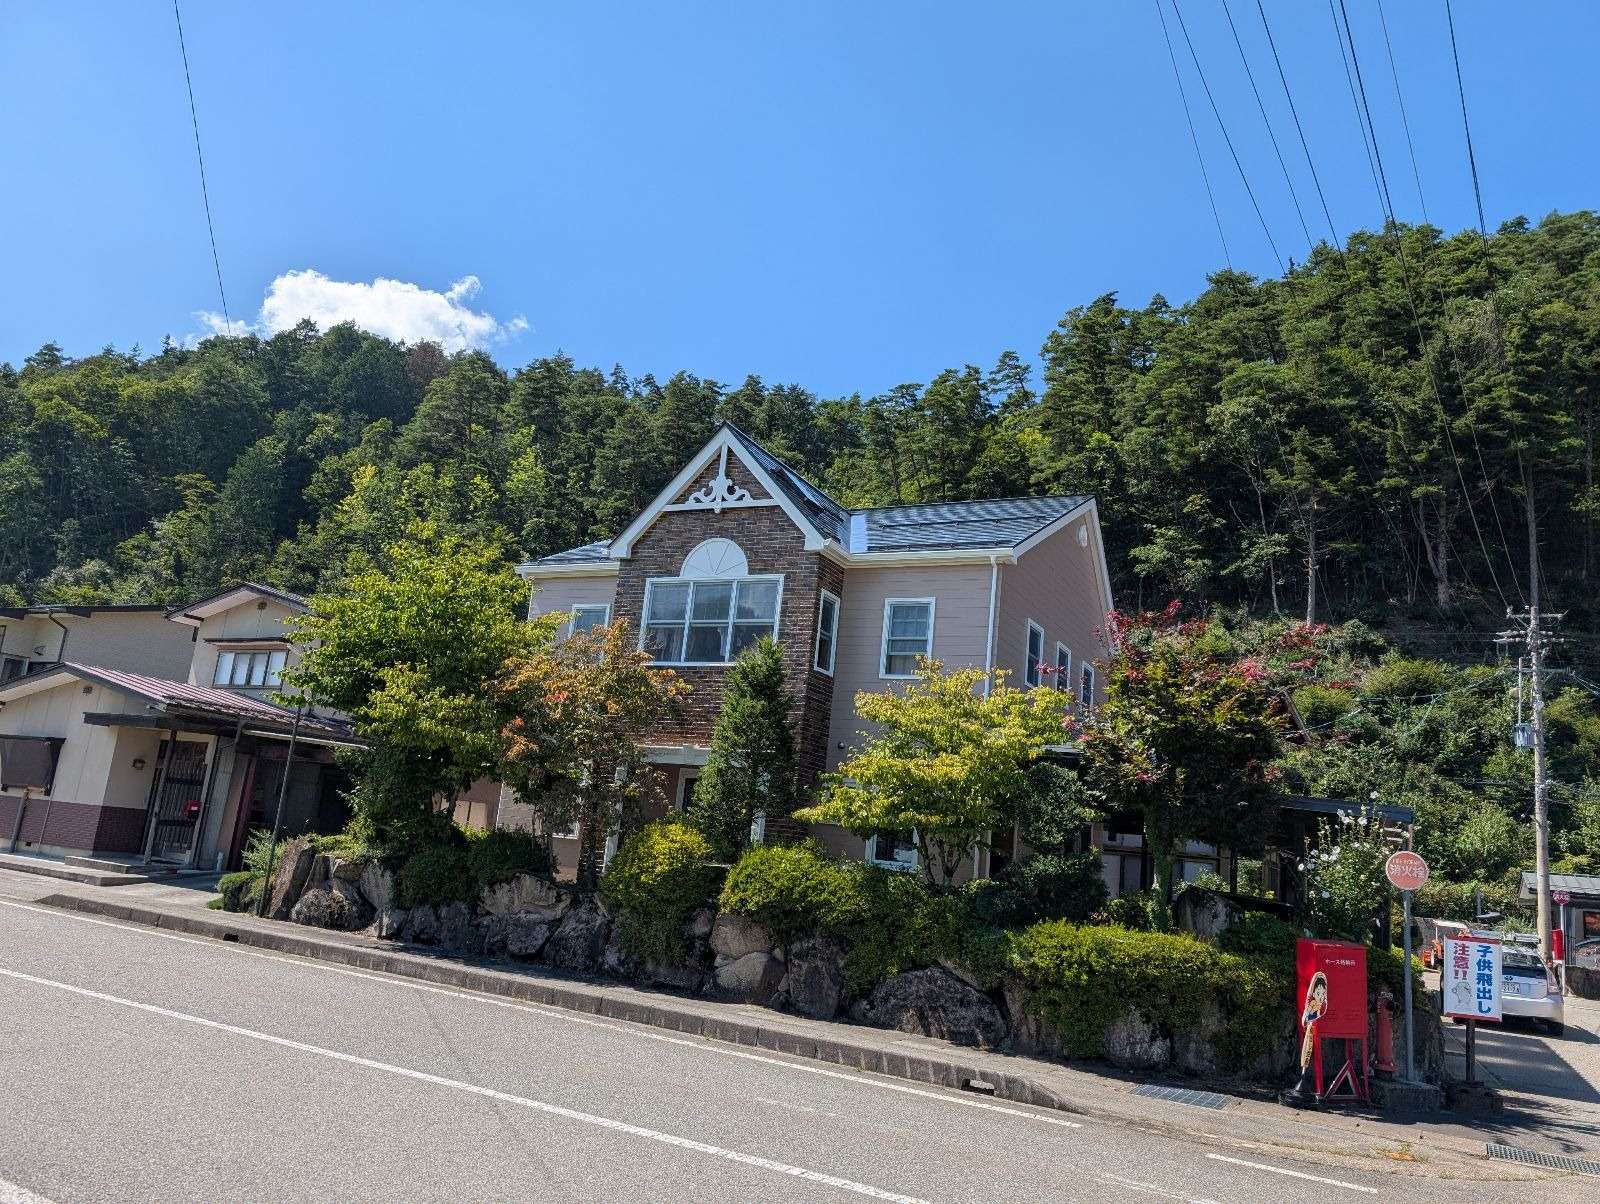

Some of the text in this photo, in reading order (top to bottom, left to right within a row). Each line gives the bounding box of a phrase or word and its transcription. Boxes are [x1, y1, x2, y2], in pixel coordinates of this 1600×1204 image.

[1389, 864, 1425, 878] 消火栓
[1476, 944, 1493, 1014] 子供飛出し
